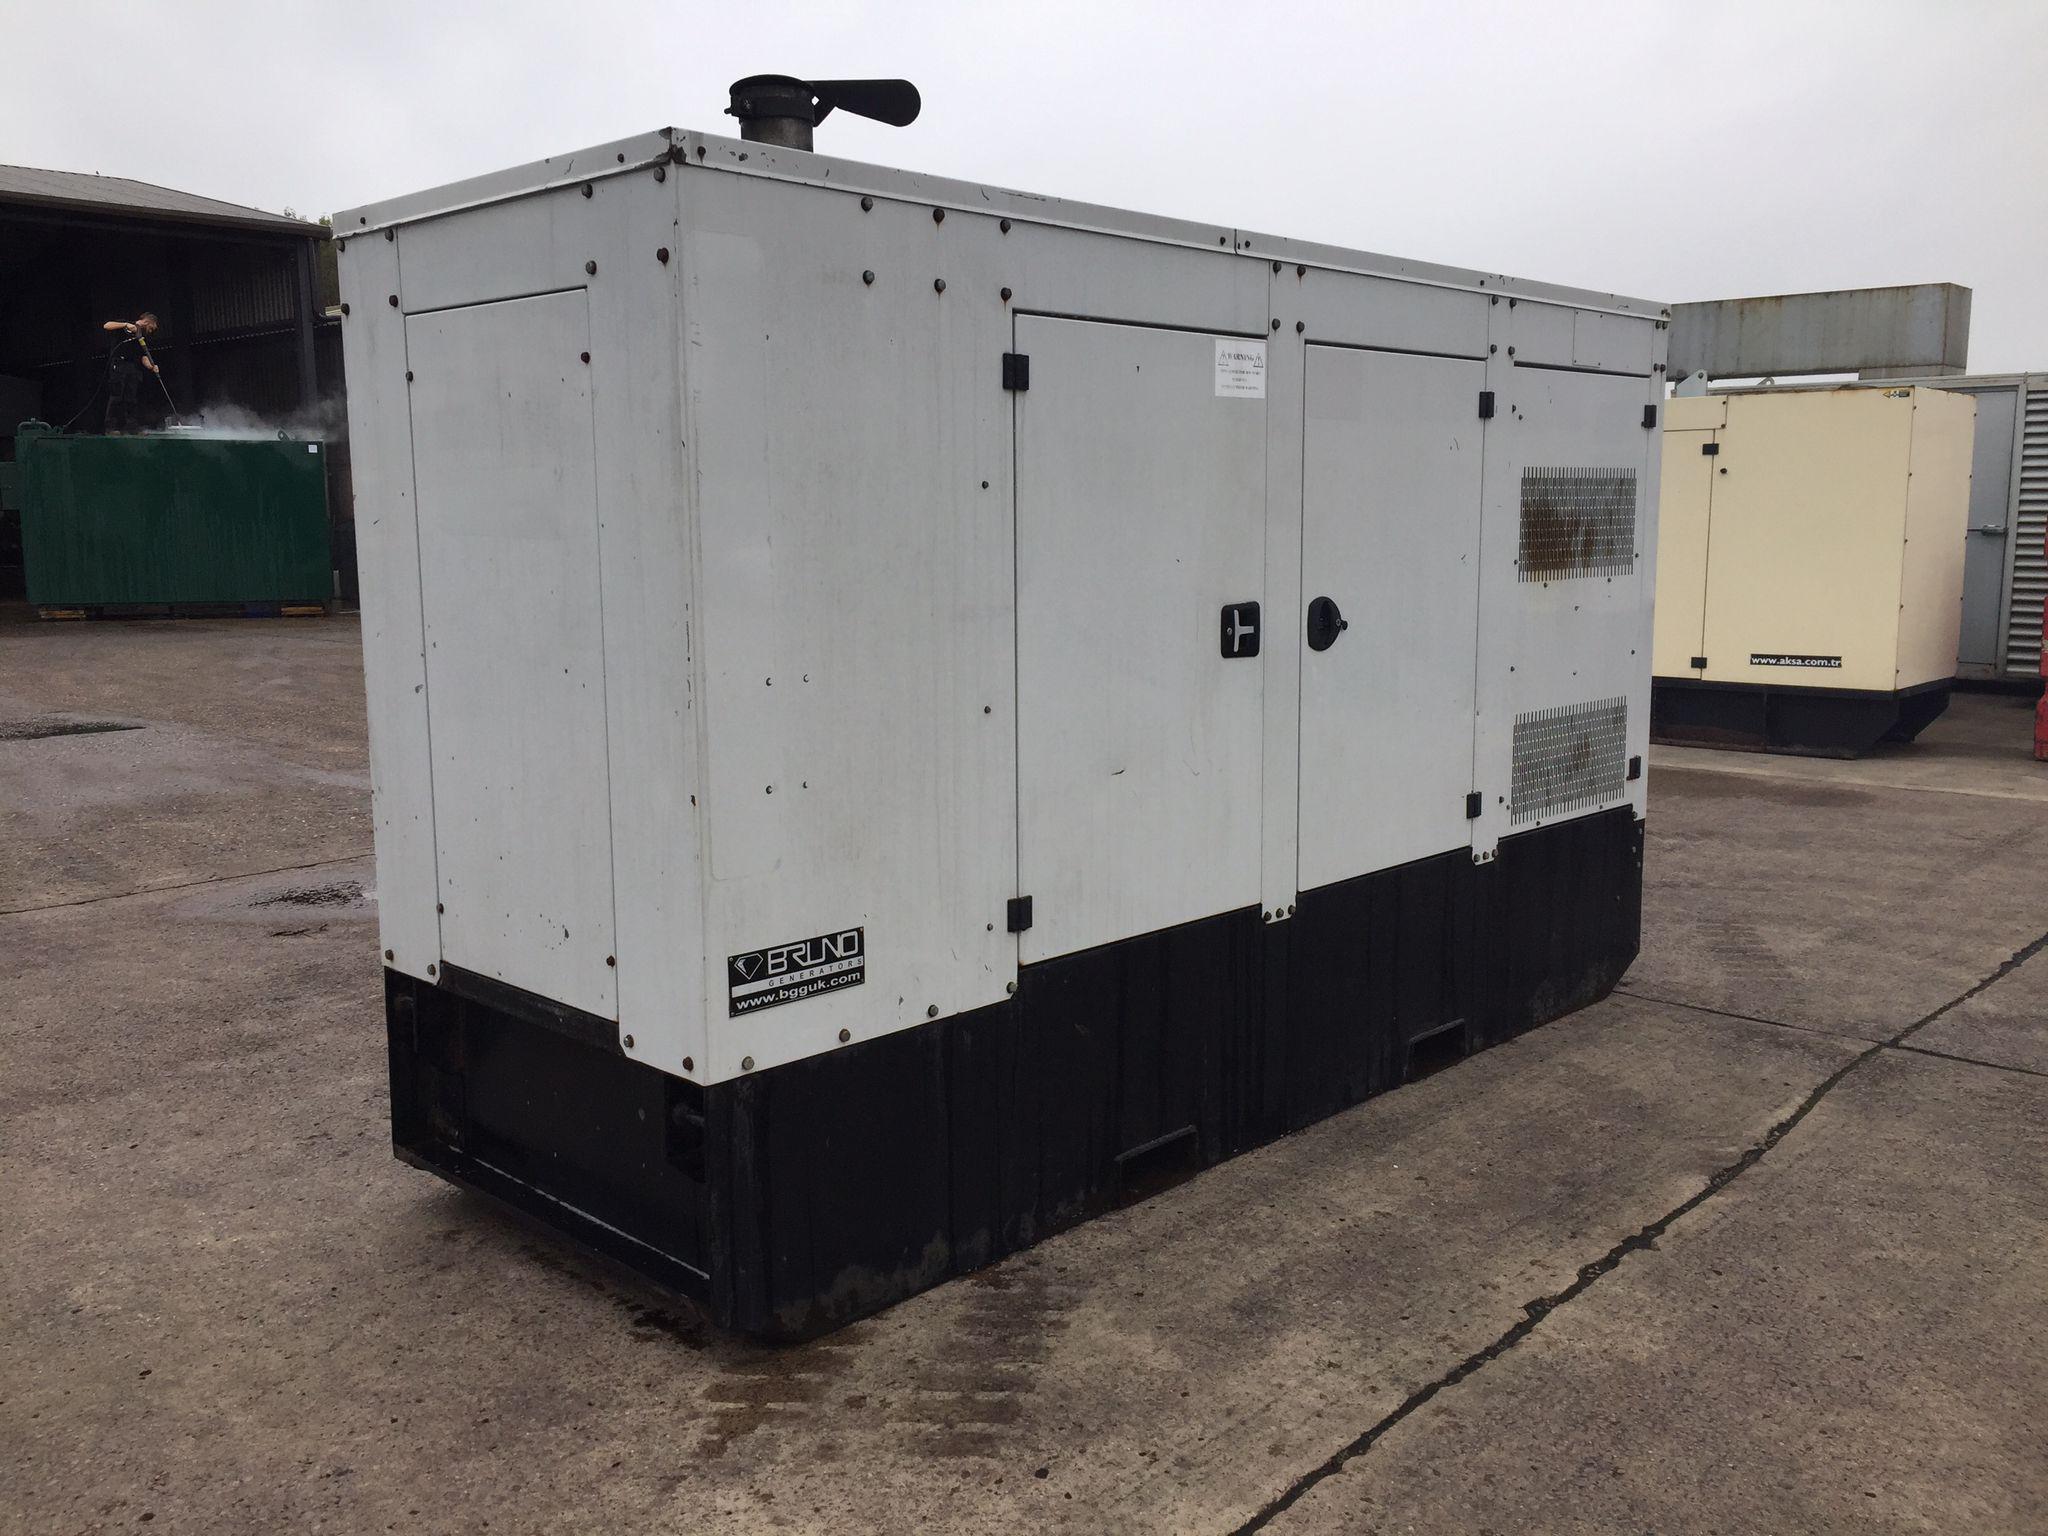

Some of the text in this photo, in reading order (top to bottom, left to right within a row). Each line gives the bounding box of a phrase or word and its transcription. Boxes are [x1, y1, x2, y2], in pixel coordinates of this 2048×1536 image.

[1751, 656, 1841, 667] www.aksa.com.tr
[767, 930, 859, 975] BRUNO
[768, 957, 863, 987] GENERATORS
[736, 971, 861, 1010] www.bgguk.com
